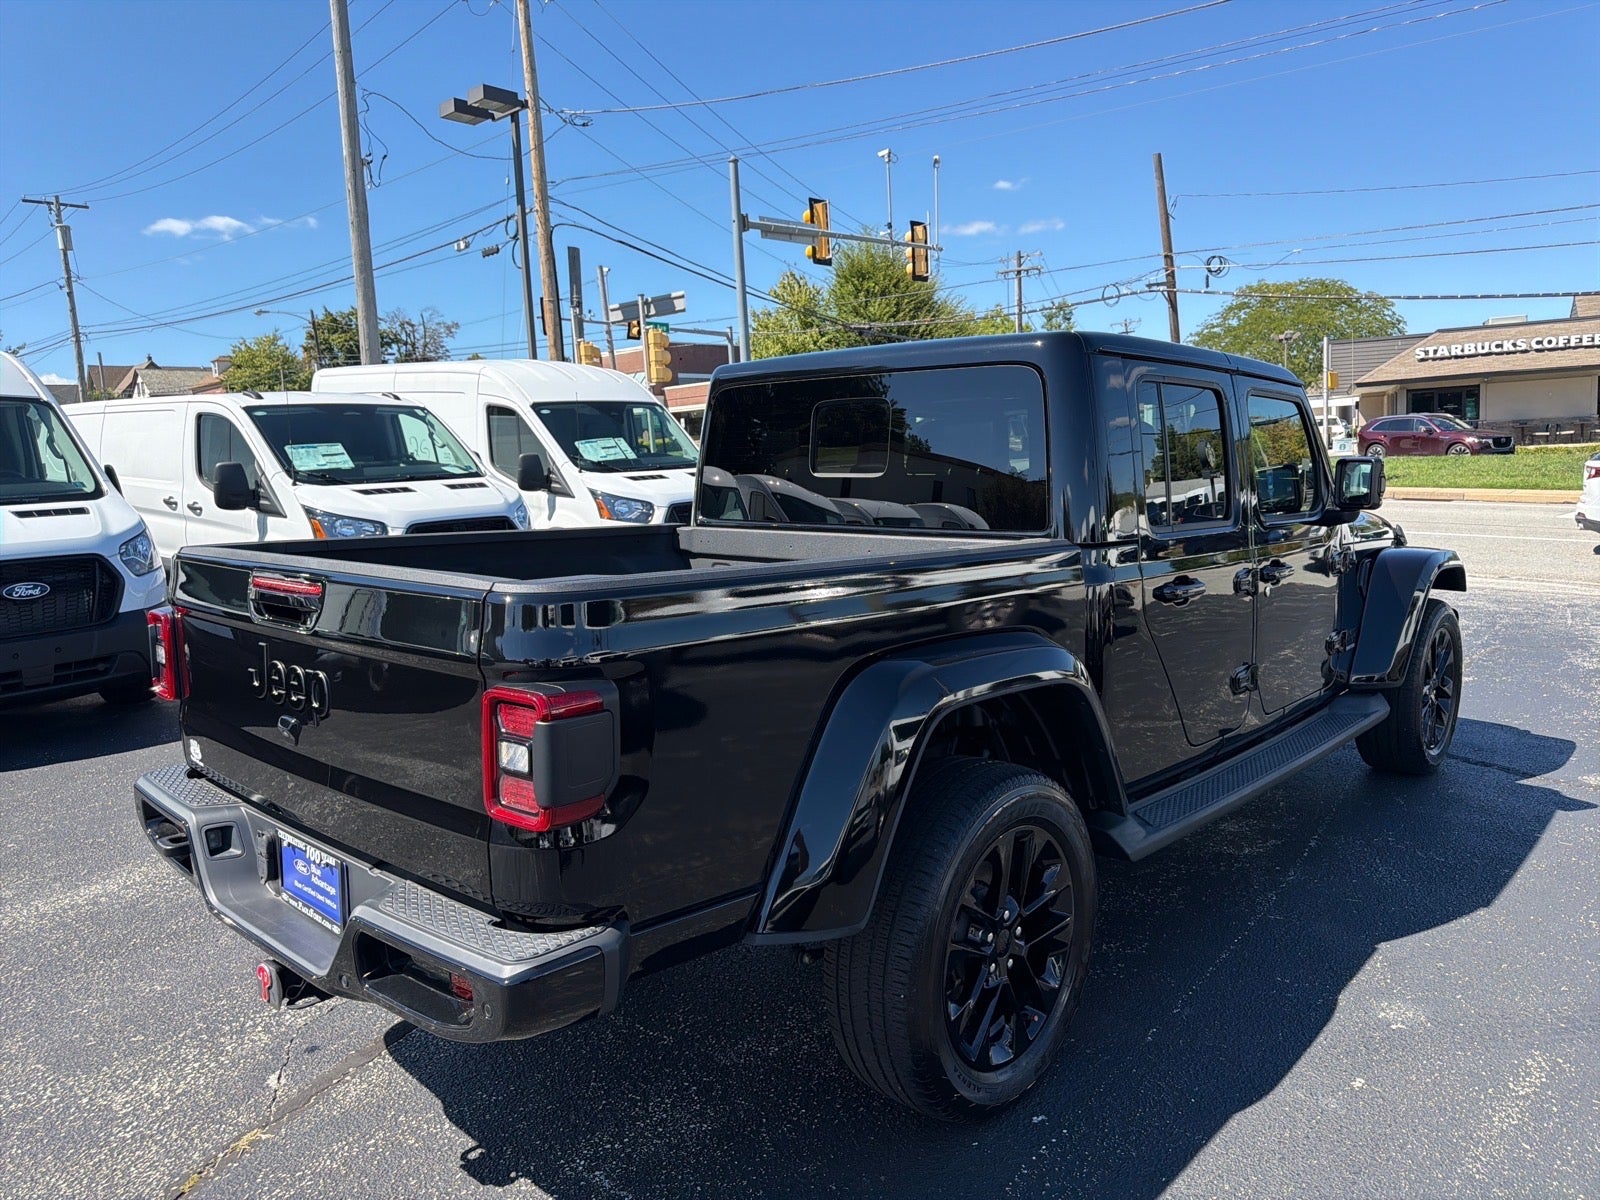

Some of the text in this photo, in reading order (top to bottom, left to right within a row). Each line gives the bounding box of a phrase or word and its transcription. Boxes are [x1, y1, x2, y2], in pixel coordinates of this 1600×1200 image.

[1415, 338, 1527, 360] STARBUCKS
[13, 585, 41, 597] Ford
[247, 641, 330, 728] Jeep
[306, 846, 321, 864] 100
[311, 863, 321, 877] Blue
[311, 874, 336, 896] Advantage
